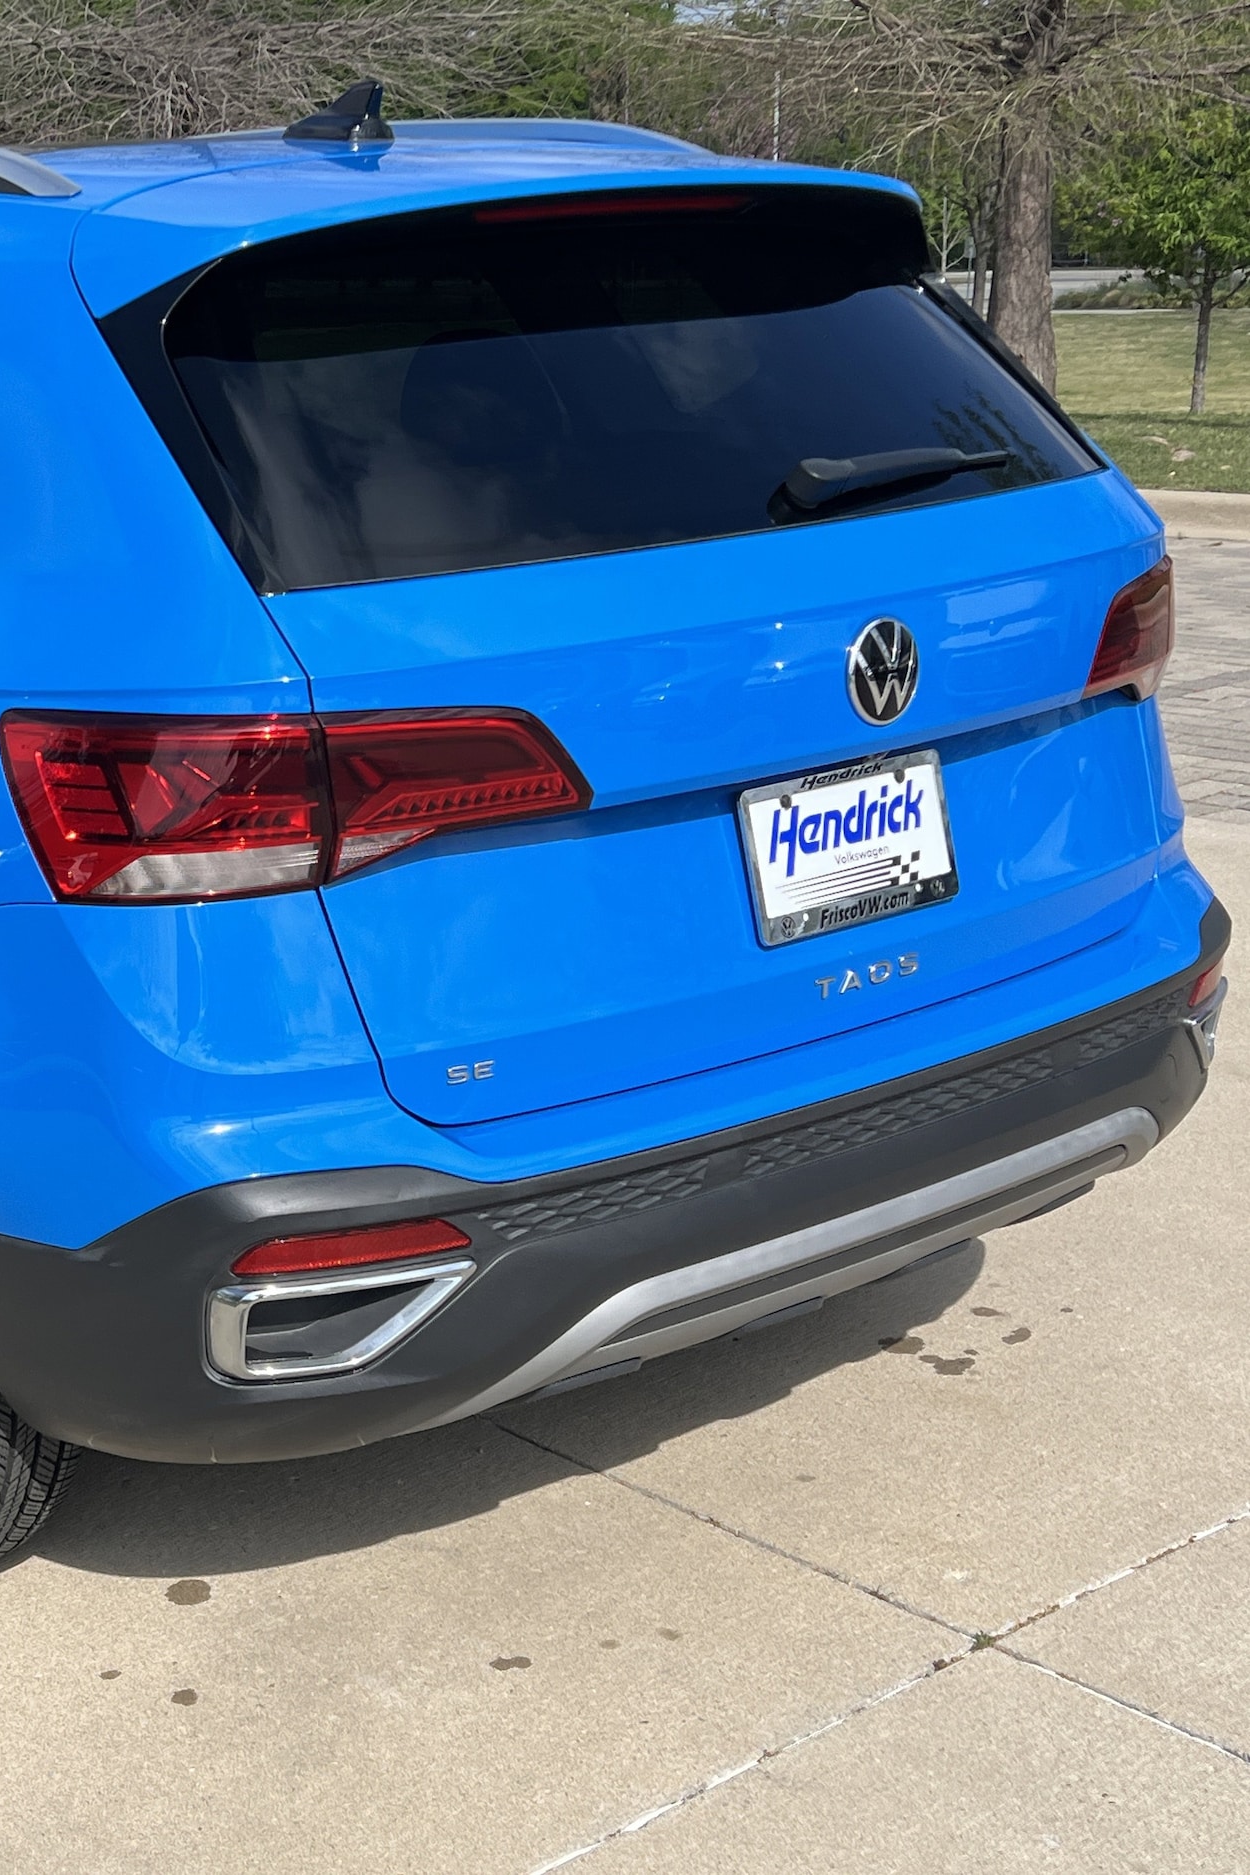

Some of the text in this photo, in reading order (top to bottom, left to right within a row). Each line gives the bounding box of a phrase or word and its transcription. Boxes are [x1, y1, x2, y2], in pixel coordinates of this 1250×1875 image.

[800, 762, 883, 789] Hendrick
[769, 780, 923, 877] Hendrick
[834, 845, 890, 865] Volkswagen
[820, 892, 910, 929] FriscoVW.com
[814, 952, 918, 1000] TAOS
[446, 1059, 495, 1085] SE
